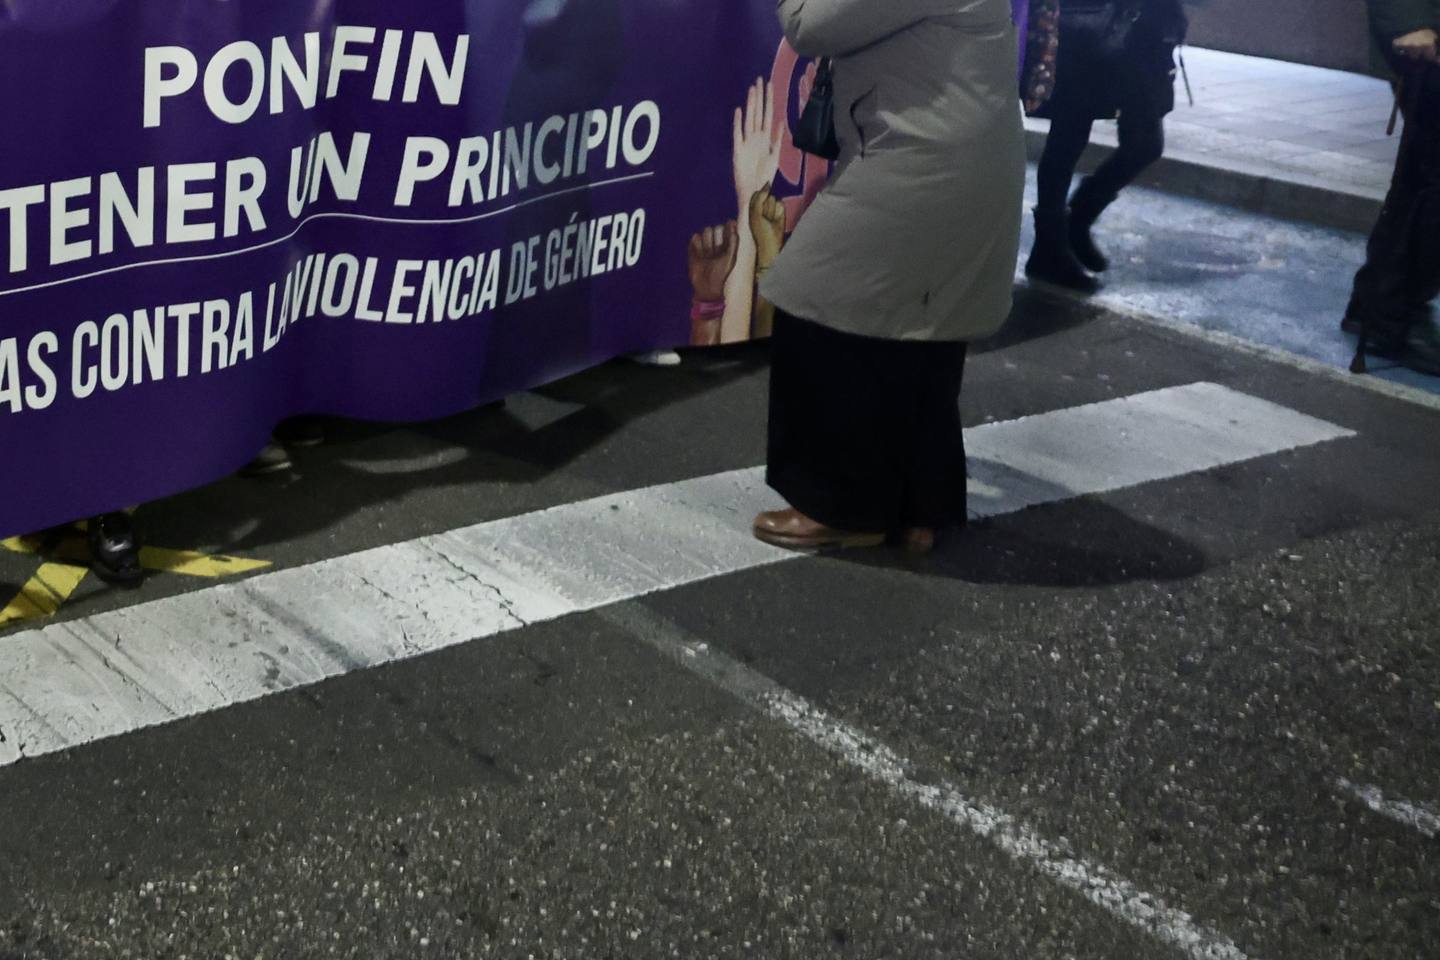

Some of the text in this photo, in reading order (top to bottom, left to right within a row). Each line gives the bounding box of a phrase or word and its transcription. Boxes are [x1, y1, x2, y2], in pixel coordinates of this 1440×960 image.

[287, 131, 371, 219] UN
[393, 99, 660, 207] PRINCIPIO
[71, 290, 254, 399] CONTRA
[290, 248, 501, 324] VIOLENCIA
[504, 239, 540, 306] DE
[543, 208, 646, 292] GÉNERO
